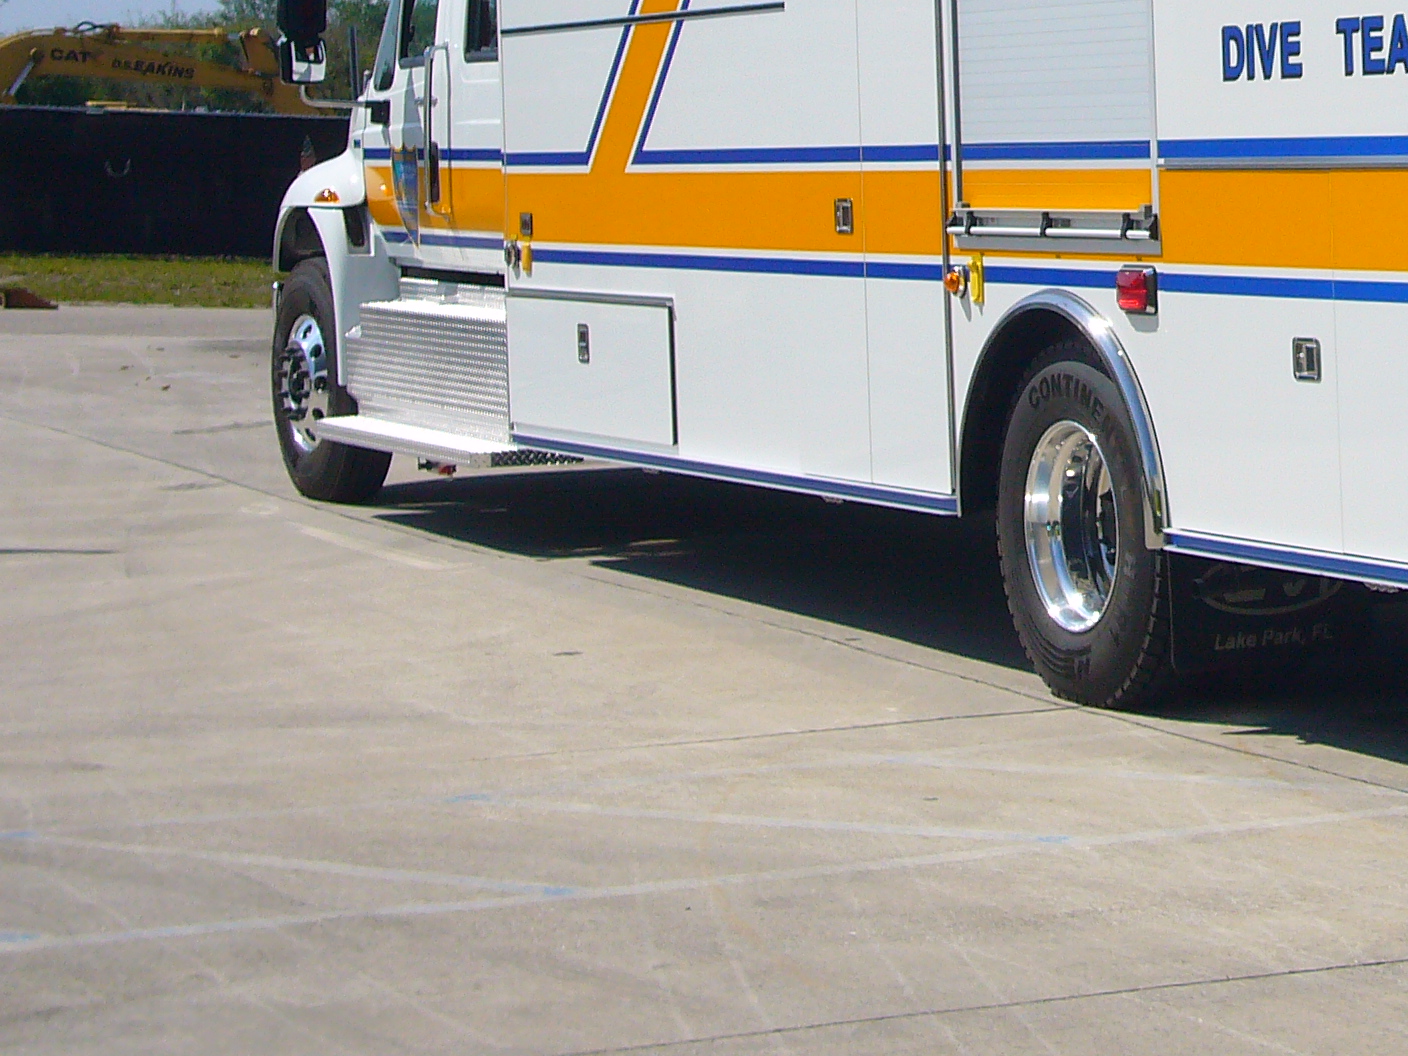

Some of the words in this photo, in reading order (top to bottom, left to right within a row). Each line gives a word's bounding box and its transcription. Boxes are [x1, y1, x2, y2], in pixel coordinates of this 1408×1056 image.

[50, 48, 92, 63] CAT
[1221, 21, 1304, 82] DIVE
[1213, 630, 1257, 651] Lake
